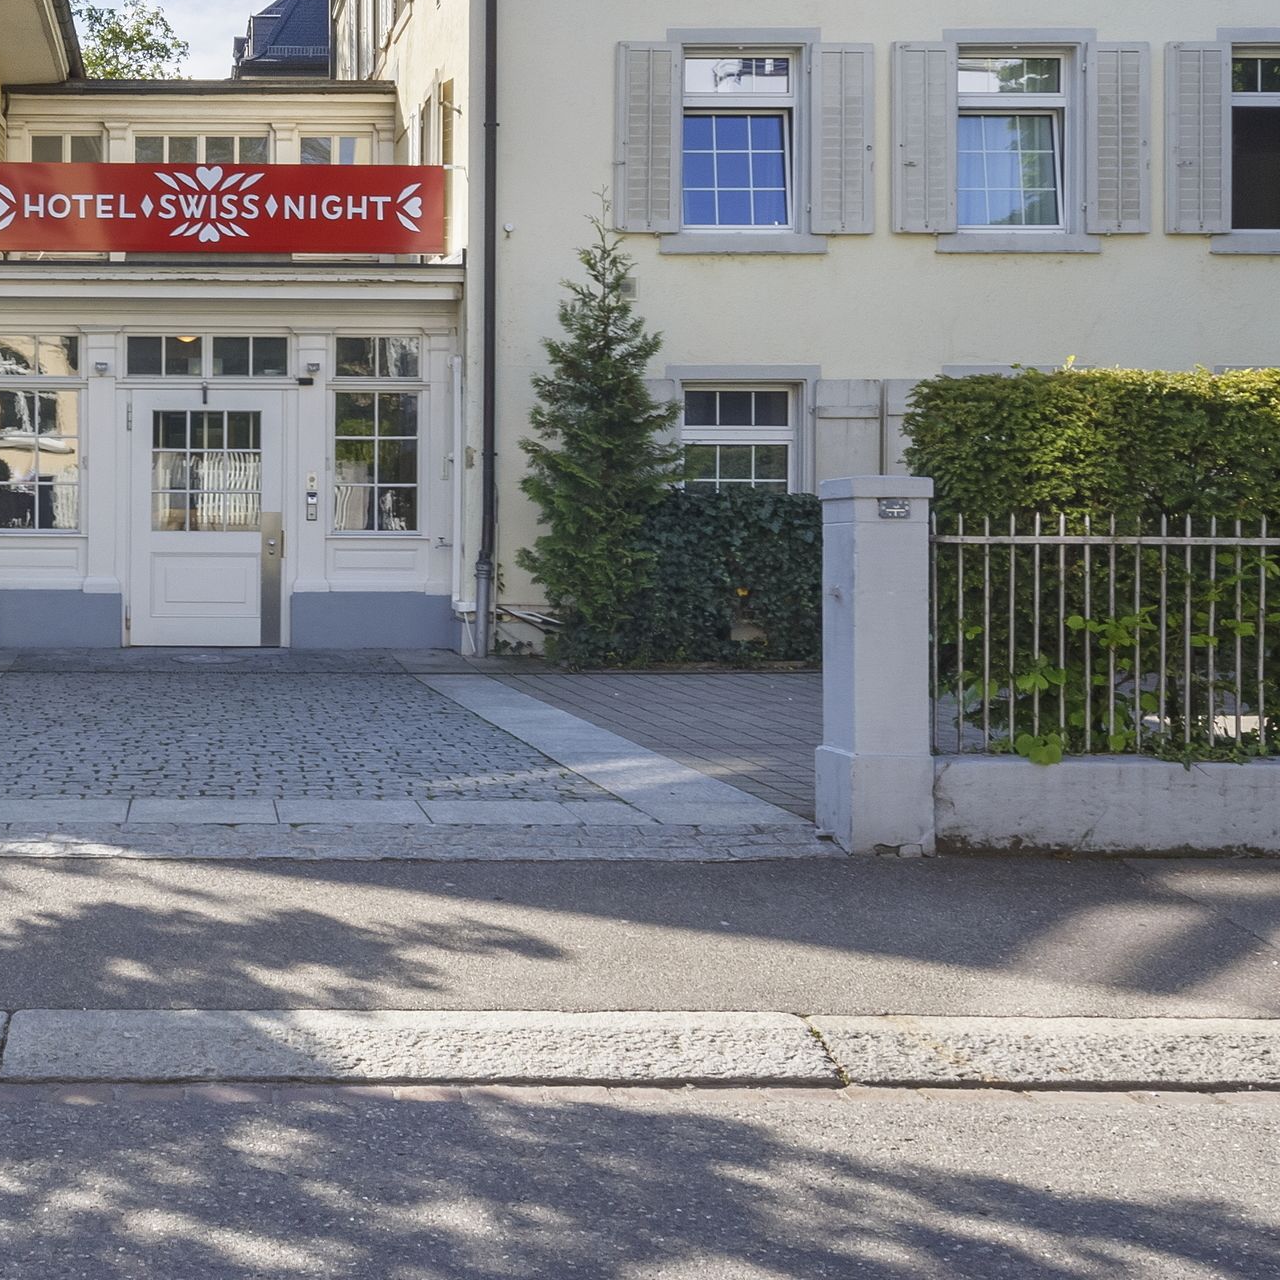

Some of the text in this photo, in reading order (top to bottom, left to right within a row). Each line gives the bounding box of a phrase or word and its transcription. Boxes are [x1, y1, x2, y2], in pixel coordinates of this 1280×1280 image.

[24, 193, 392, 221] HOTEL SWISS NIGHT
